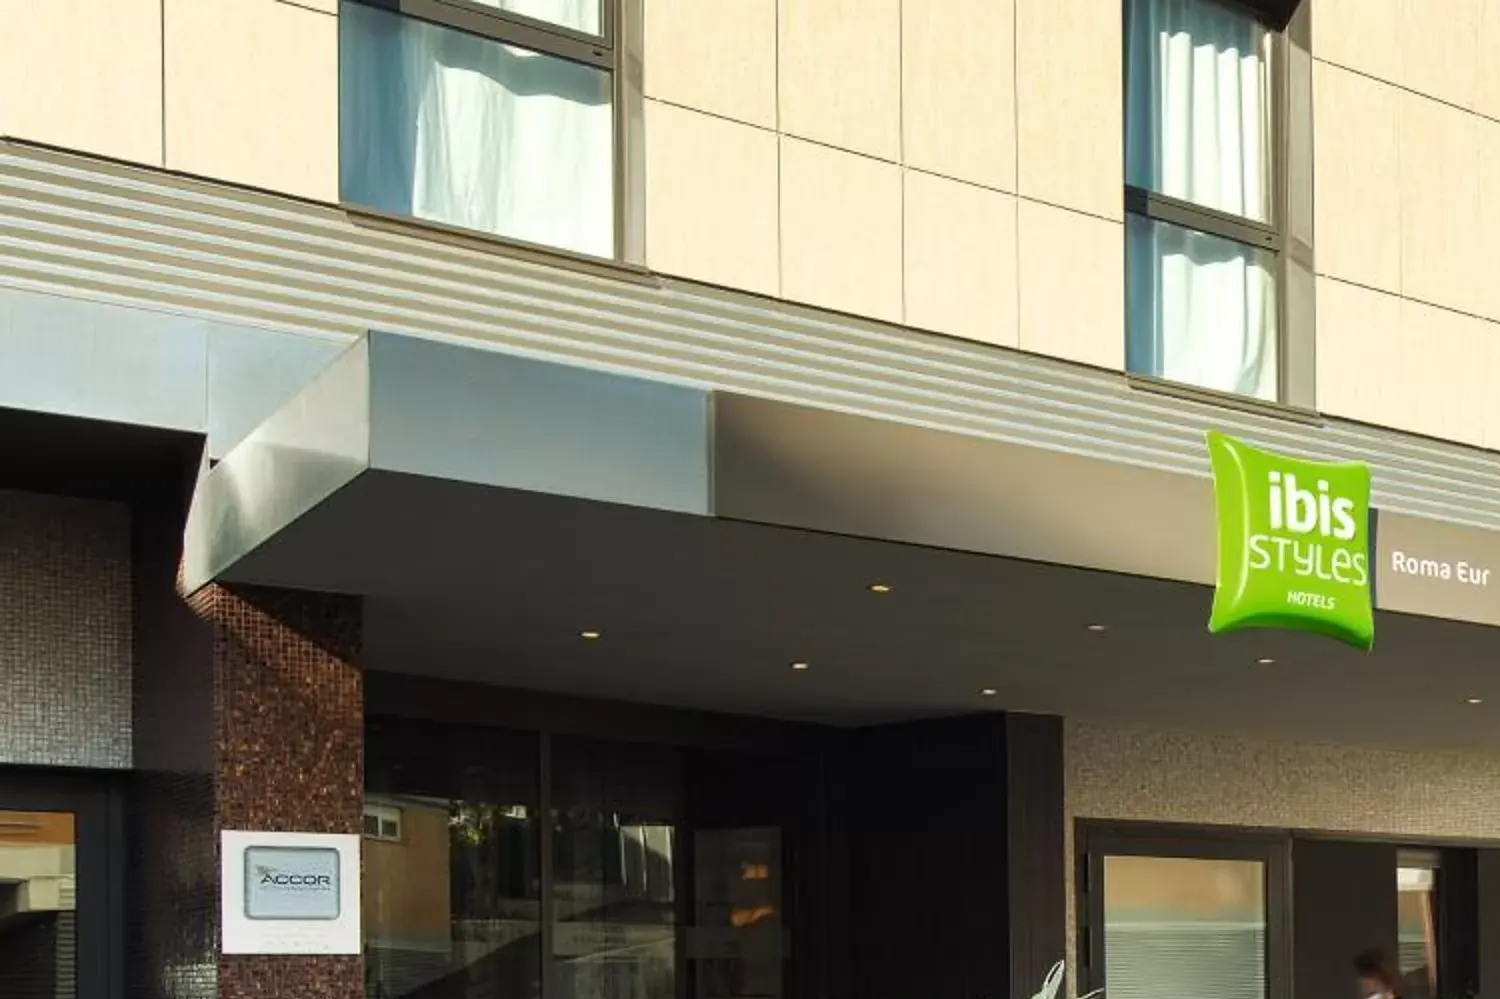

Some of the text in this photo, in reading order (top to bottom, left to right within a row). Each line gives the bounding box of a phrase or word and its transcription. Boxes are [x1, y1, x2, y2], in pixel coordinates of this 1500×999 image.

[1268, 471, 1357, 540] ibis
[1392, 551, 1490, 586] Roma Eur
[1287, 591, 1335, 610] HOTELS
[260, 873, 331, 885] ACCOR
